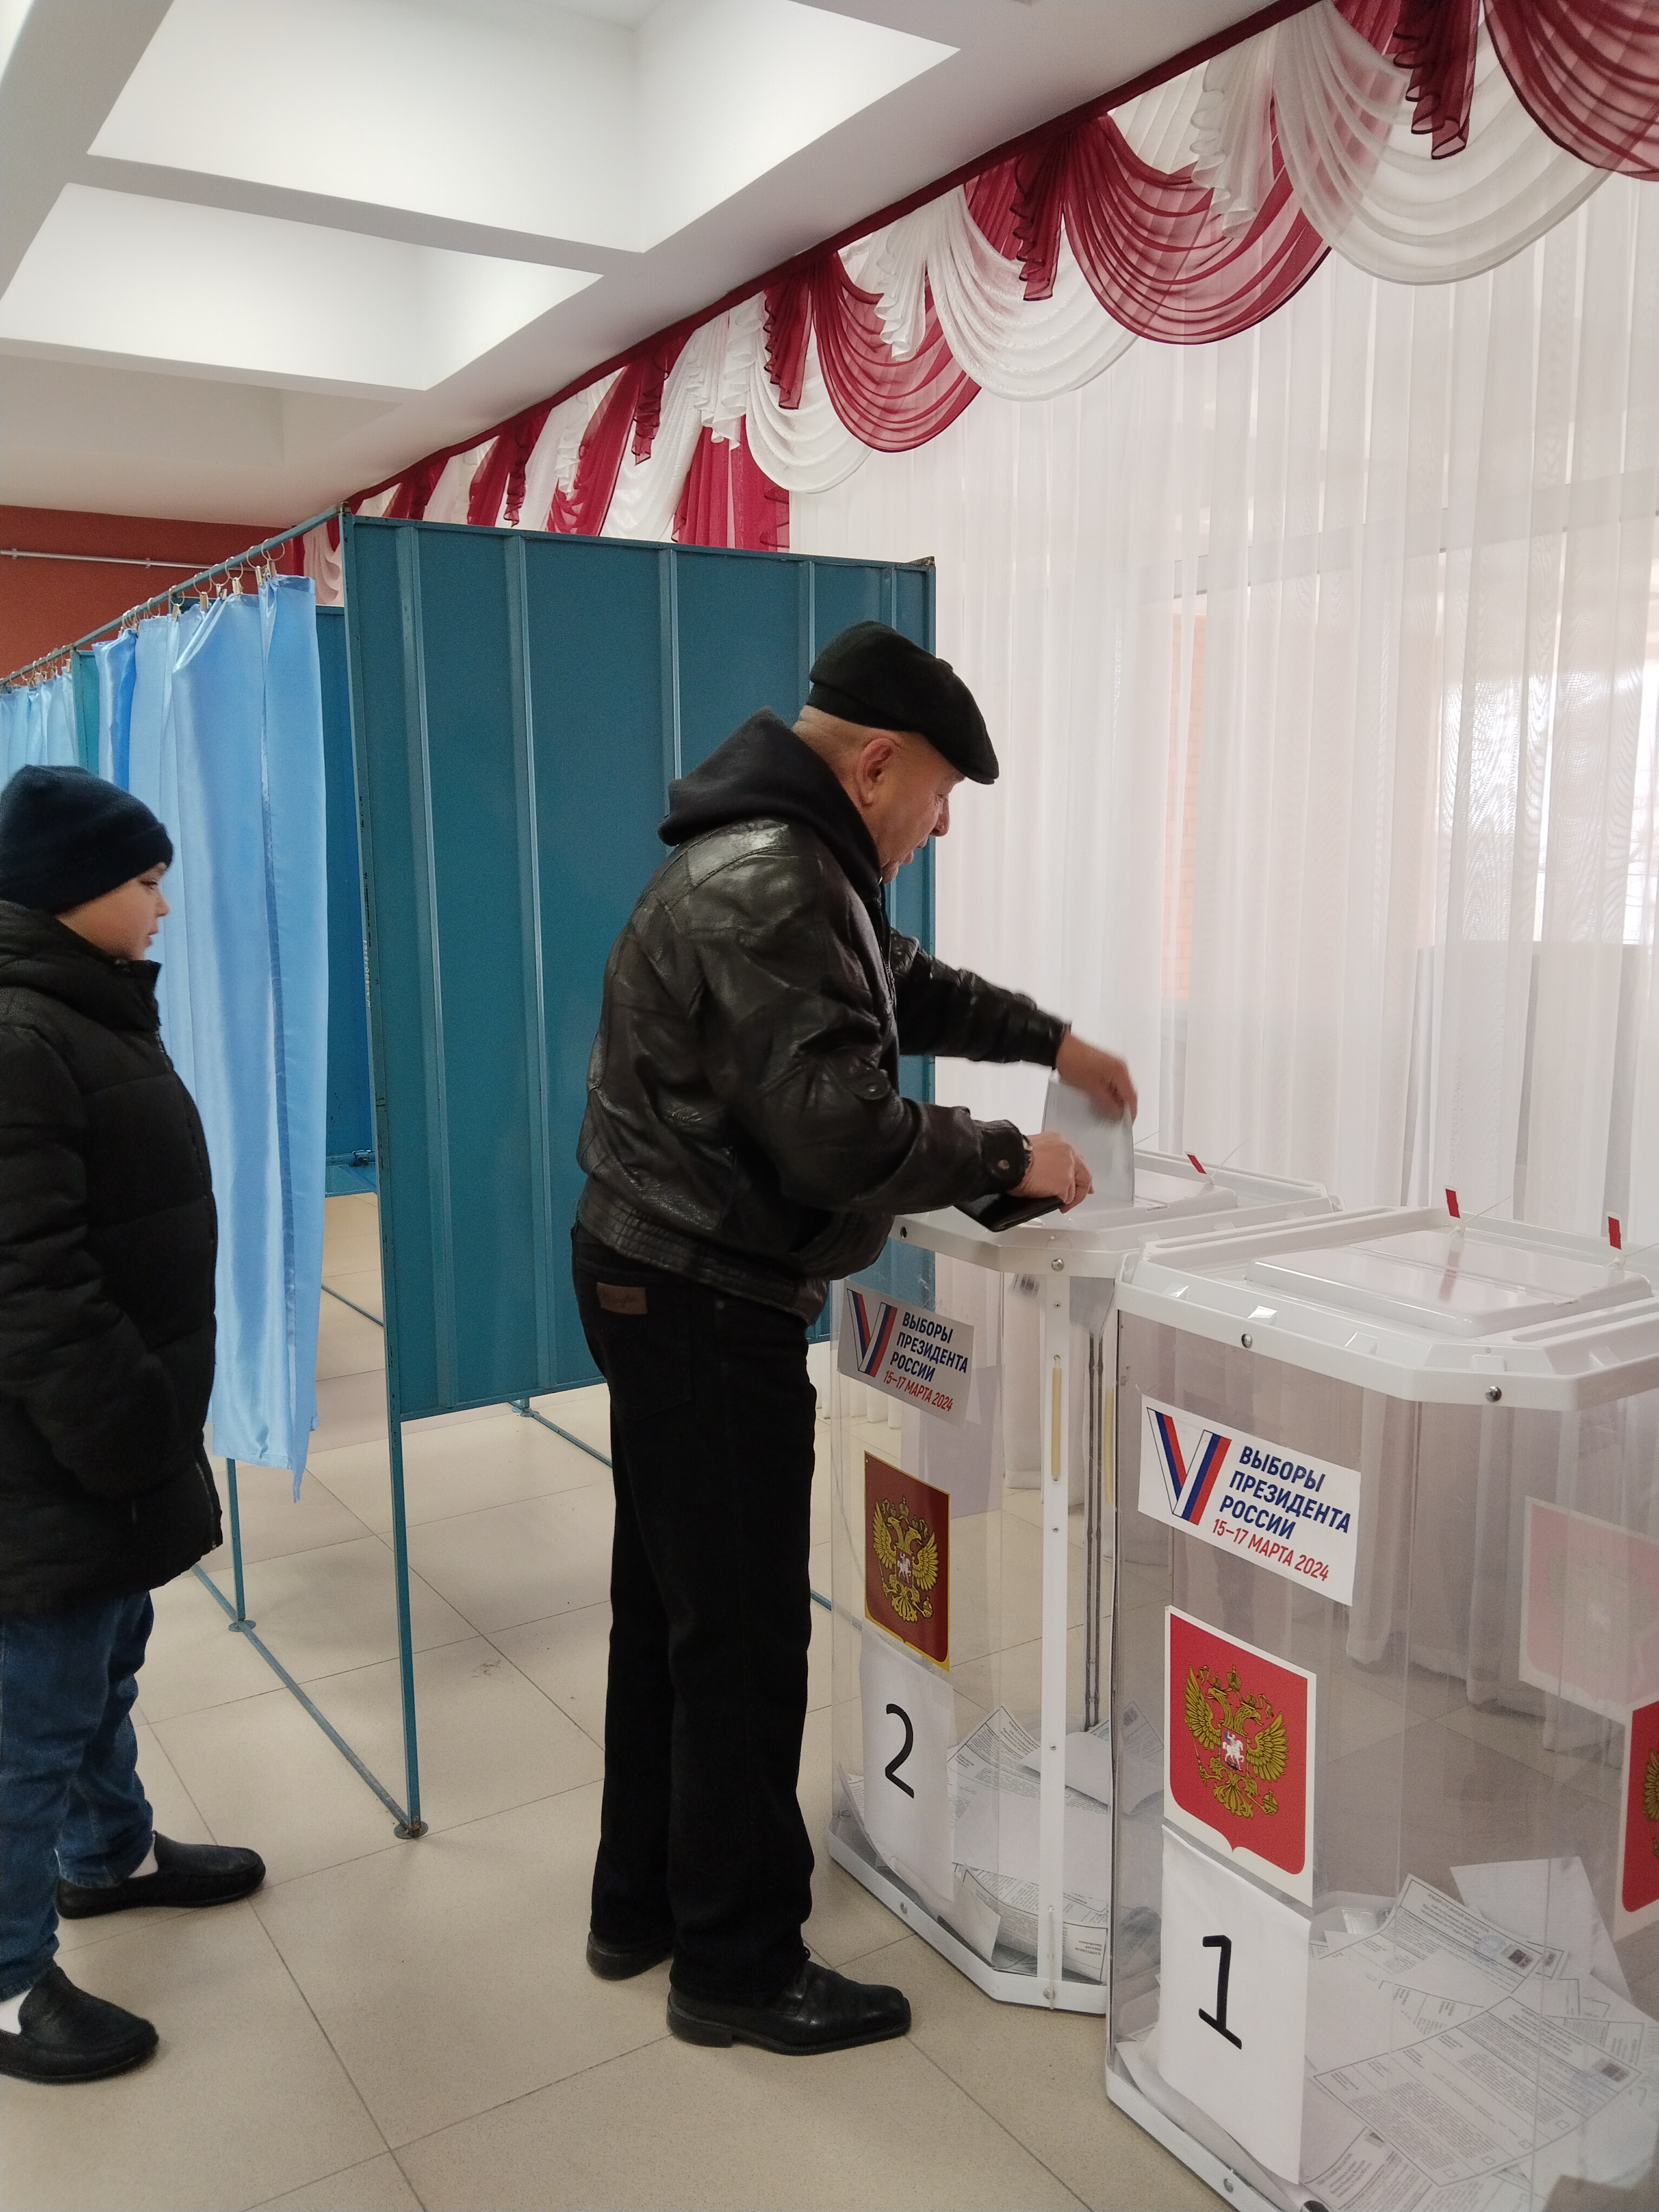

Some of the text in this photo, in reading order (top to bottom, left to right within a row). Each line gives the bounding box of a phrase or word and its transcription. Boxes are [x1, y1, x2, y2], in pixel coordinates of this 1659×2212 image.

[902, 1311, 953, 1343] ВЫБОРЫ
[890, 1351, 935, 1382] РОССИИ
[896, 1332, 968, 1373] ПРЕЗИДЕНТА
[904, 1379, 933, 1403] МАРТА
[931, 1392, 953, 1411] 2024
[1239, 1445, 1326, 1492] ВЫБОРЫ
[1219, 1495, 1296, 1539] РОССИИ
[1229, 1470, 1351, 1533] ПРЕЗИДЕНТА
[1248, 1534, 1294, 1566] МАРТА
[1294, 1554, 1329, 1581] 2024
[885, 1703, 914, 1799] 2
[1199, 1935, 1242, 2049] 1
